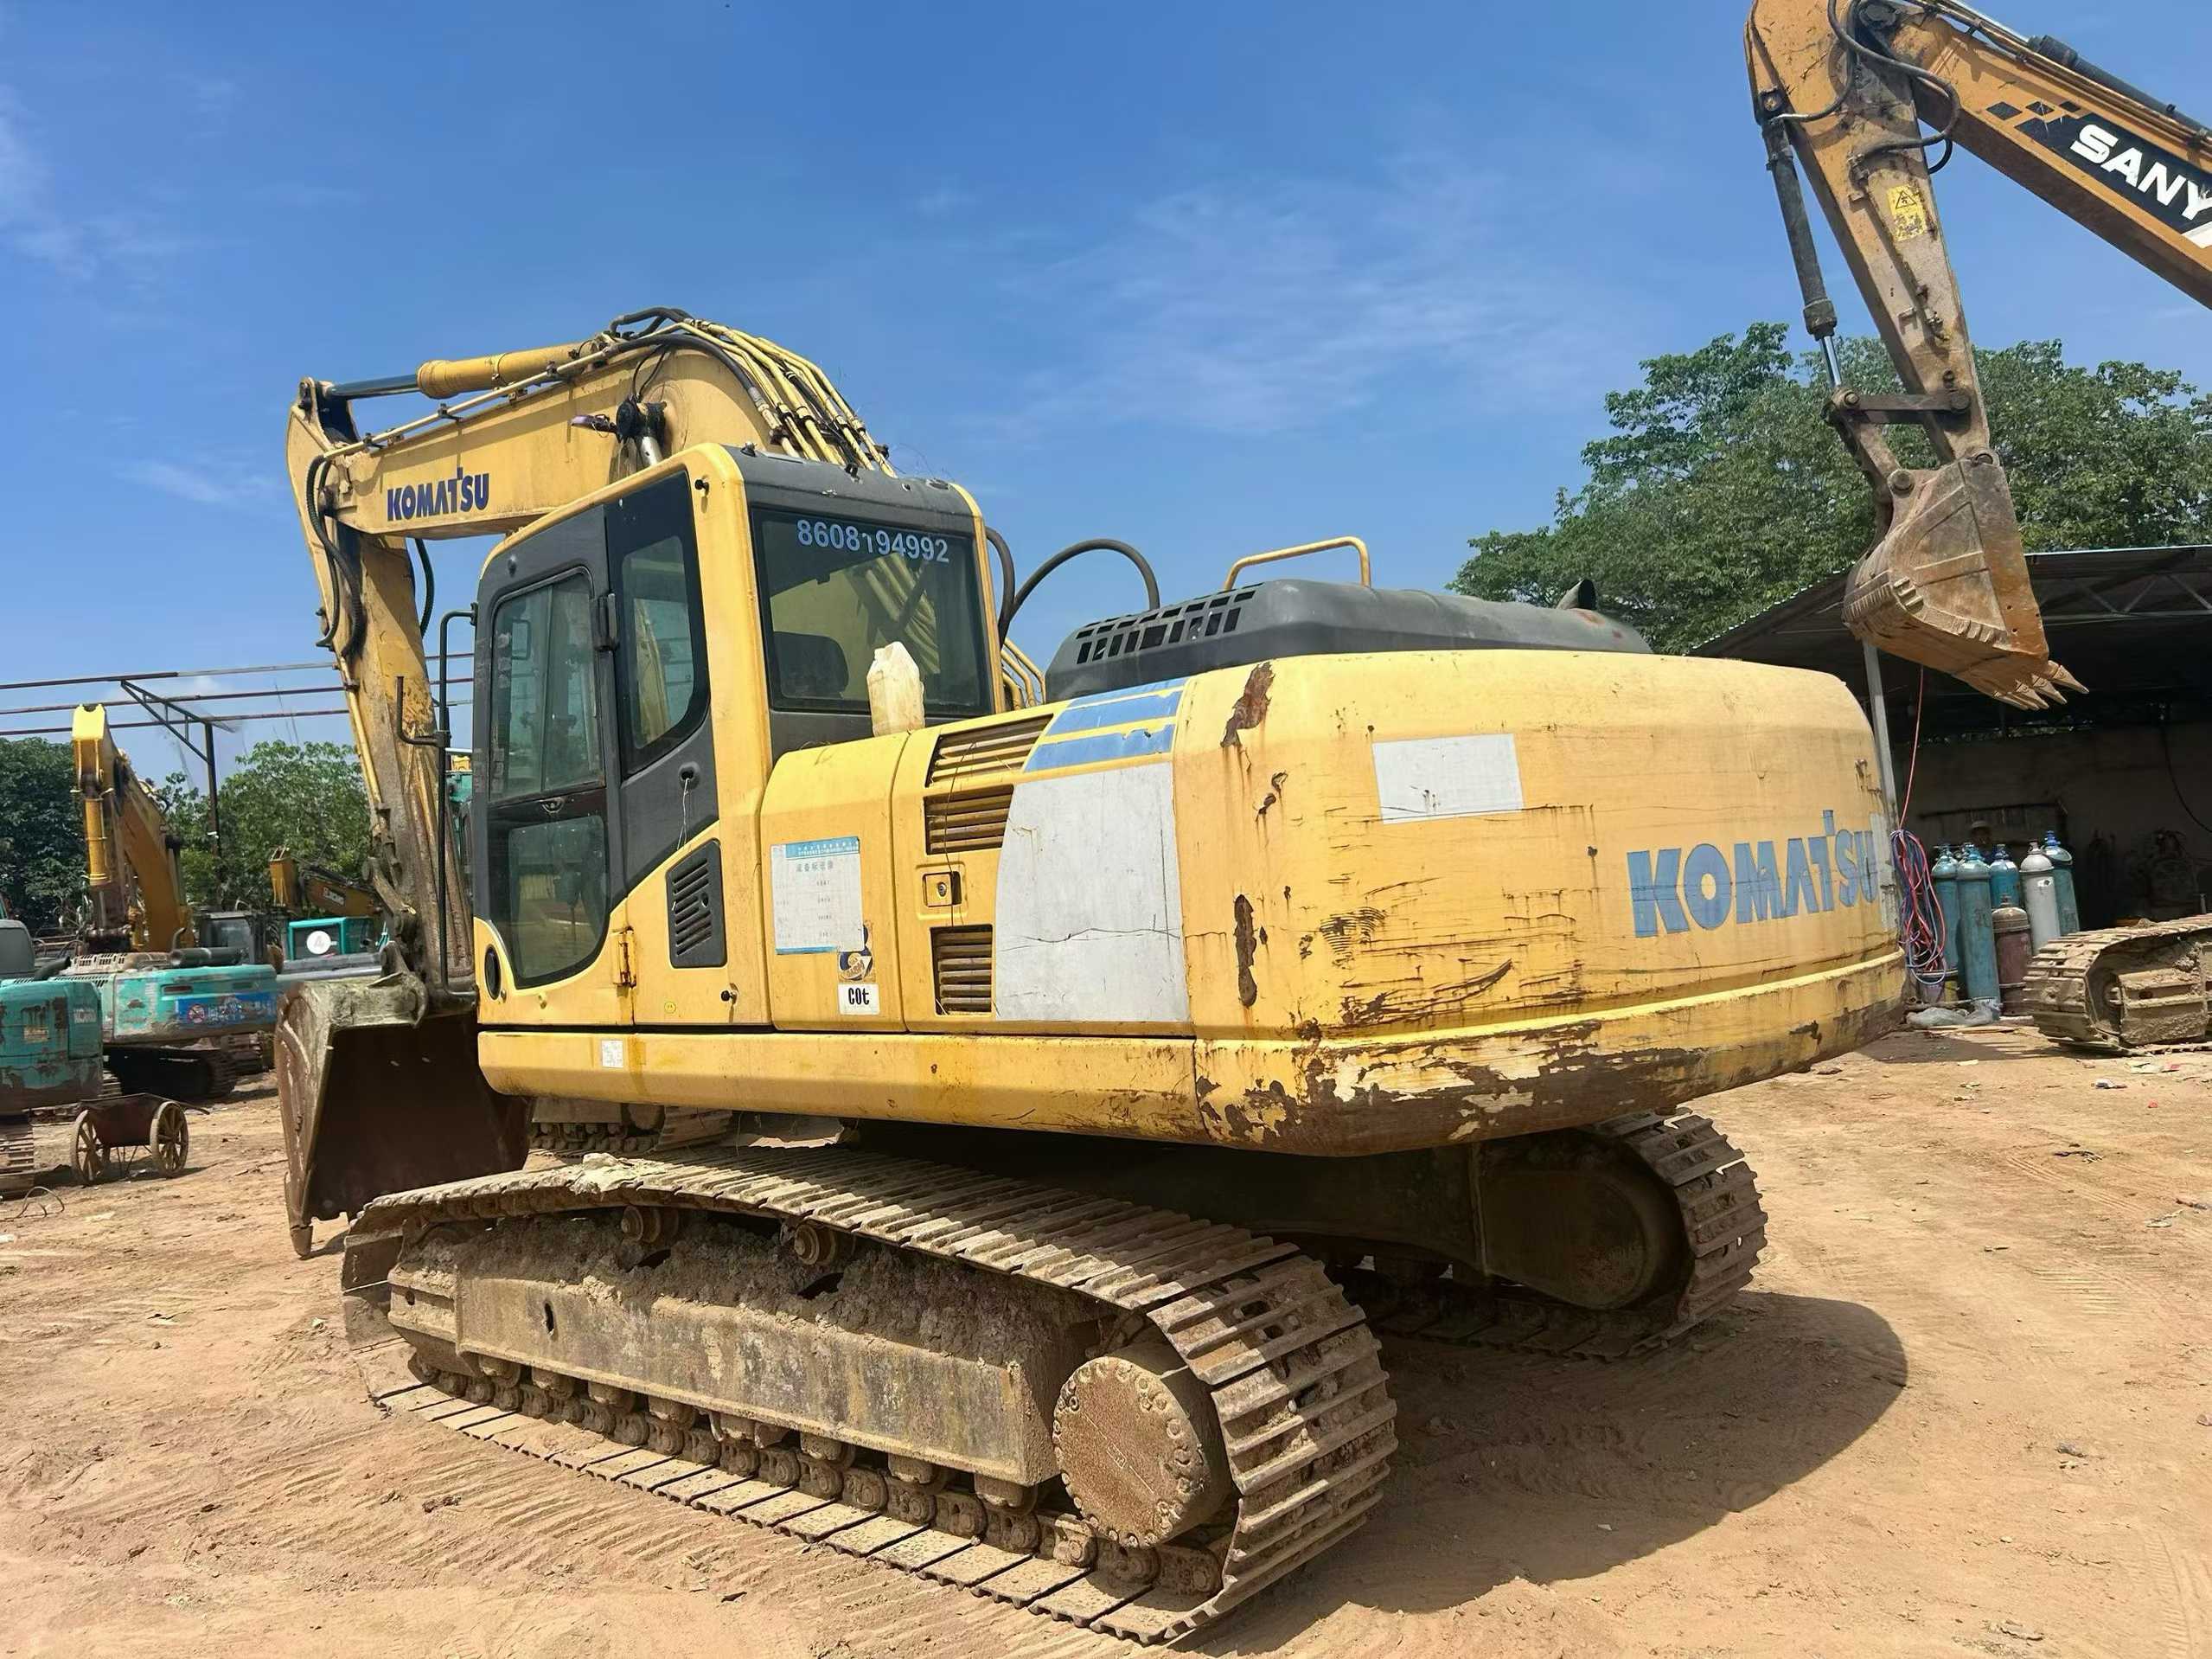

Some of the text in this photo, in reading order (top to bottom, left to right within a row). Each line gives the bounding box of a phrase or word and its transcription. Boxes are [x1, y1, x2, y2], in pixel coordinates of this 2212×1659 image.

[2069, 124, 2212, 221] SANY
[387, 466, 489, 522] KOMATSU
[1627, 810, 1879, 938] KOMATSU
